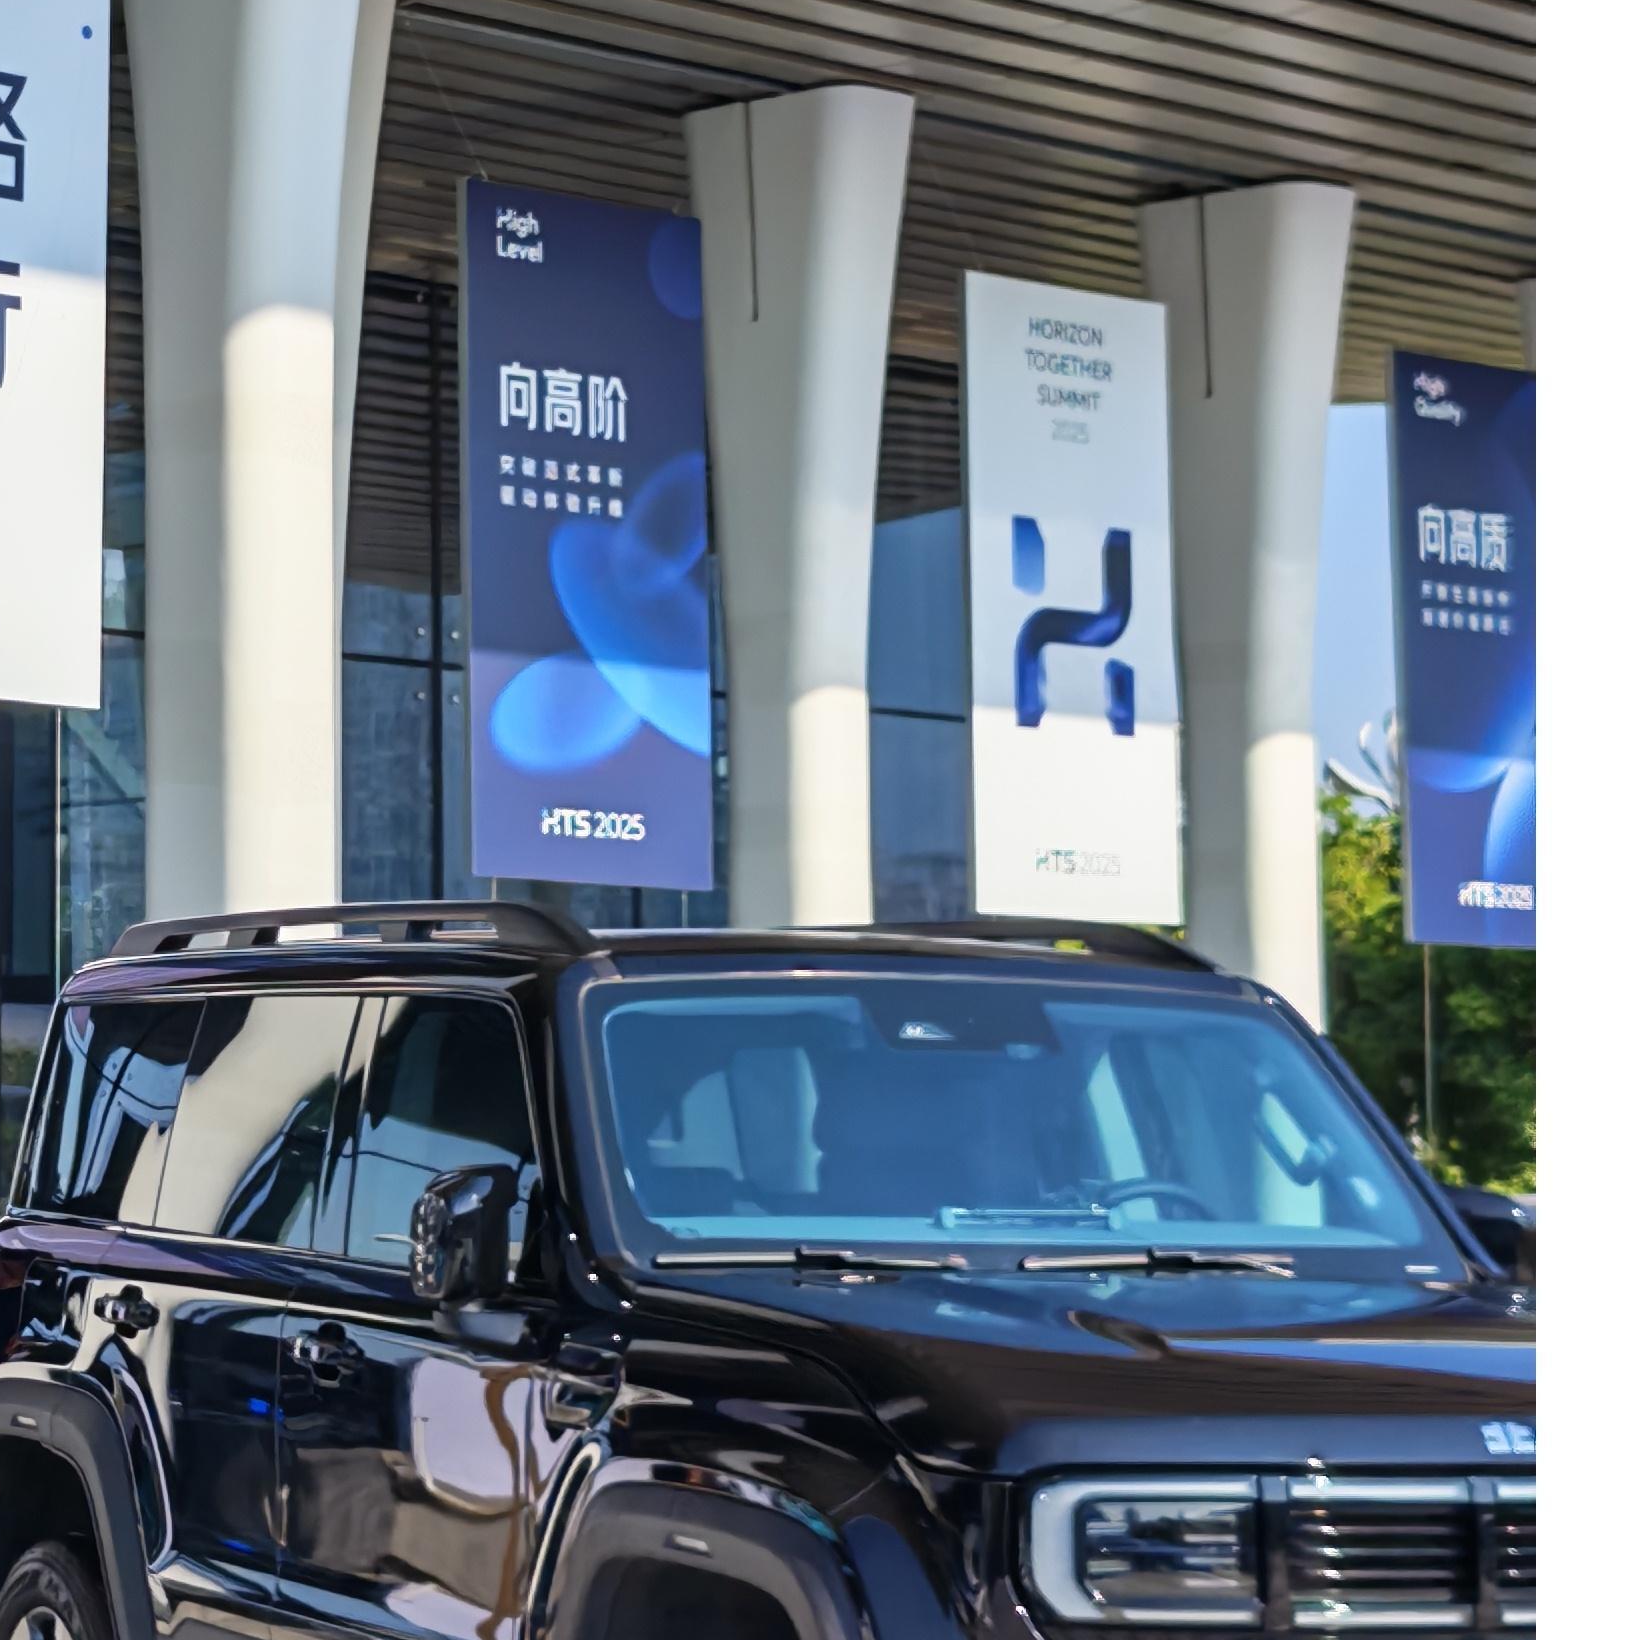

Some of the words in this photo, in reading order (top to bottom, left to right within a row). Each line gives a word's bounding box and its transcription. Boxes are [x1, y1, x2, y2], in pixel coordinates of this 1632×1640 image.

[497, 235, 543, 262] Level
[1028, 317, 1103, 347] HORIZON
[1025, 347, 1112, 380] TOGETHER
[499, 362, 628, 442] 向高阶
[541, 807, 591, 838] HTS
[594, 812, 646, 840] 2025
